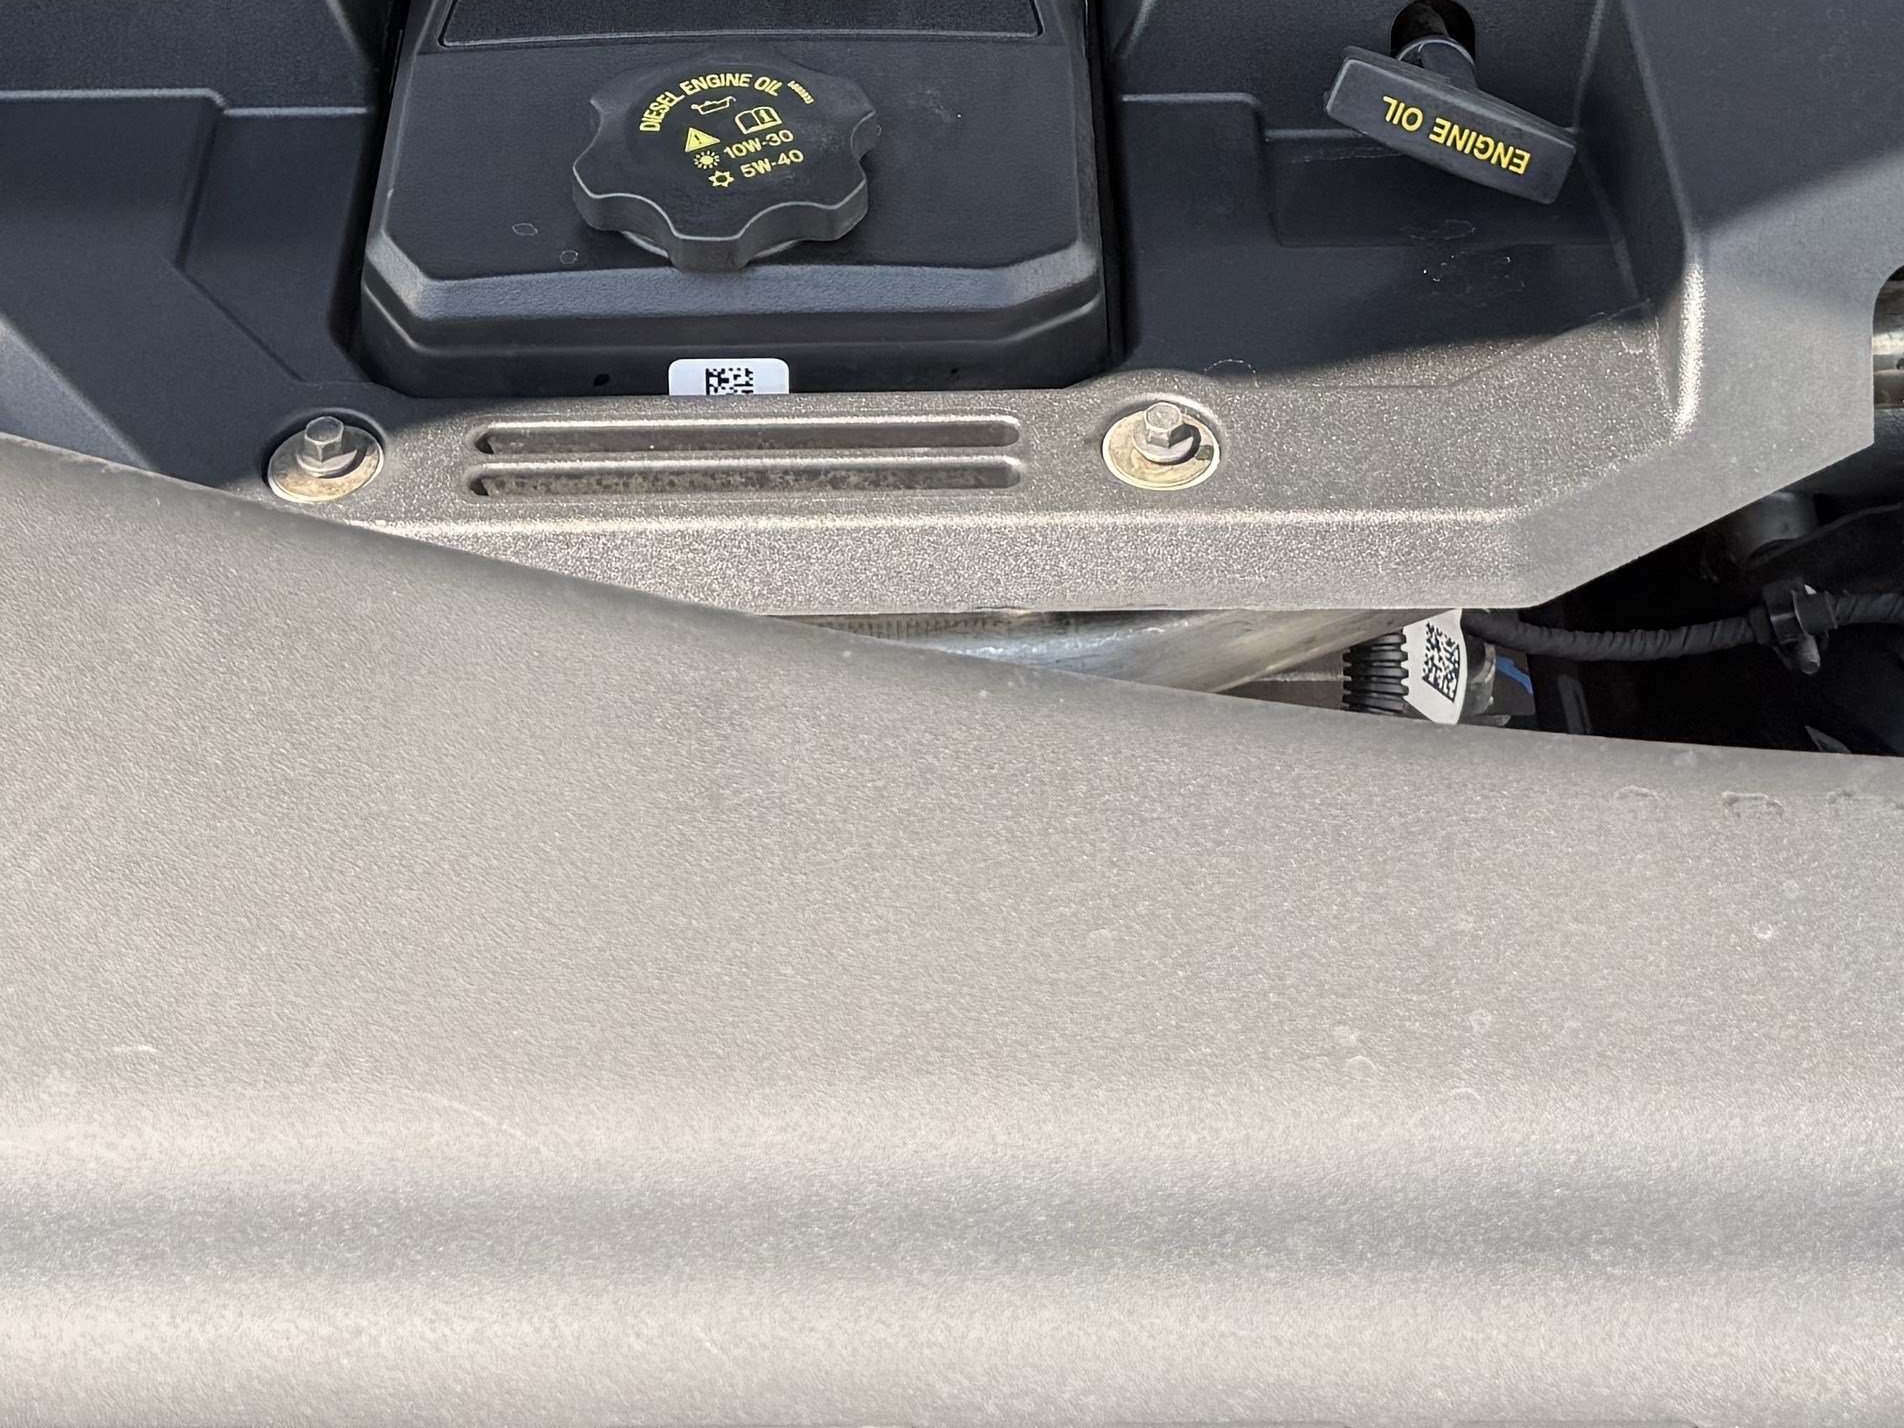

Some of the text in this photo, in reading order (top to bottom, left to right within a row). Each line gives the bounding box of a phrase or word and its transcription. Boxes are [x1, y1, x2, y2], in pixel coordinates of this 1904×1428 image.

[639, 91, 685, 132] DIESEL
[679, 73, 752, 95] ENGINE
[754, 76, 783, 96] OIL
[723, 129, 794, 159] 10W-30
[1383, 95, 1531, 175] ENGINE OIL
[739, 149, 804, 178] 5W-40
